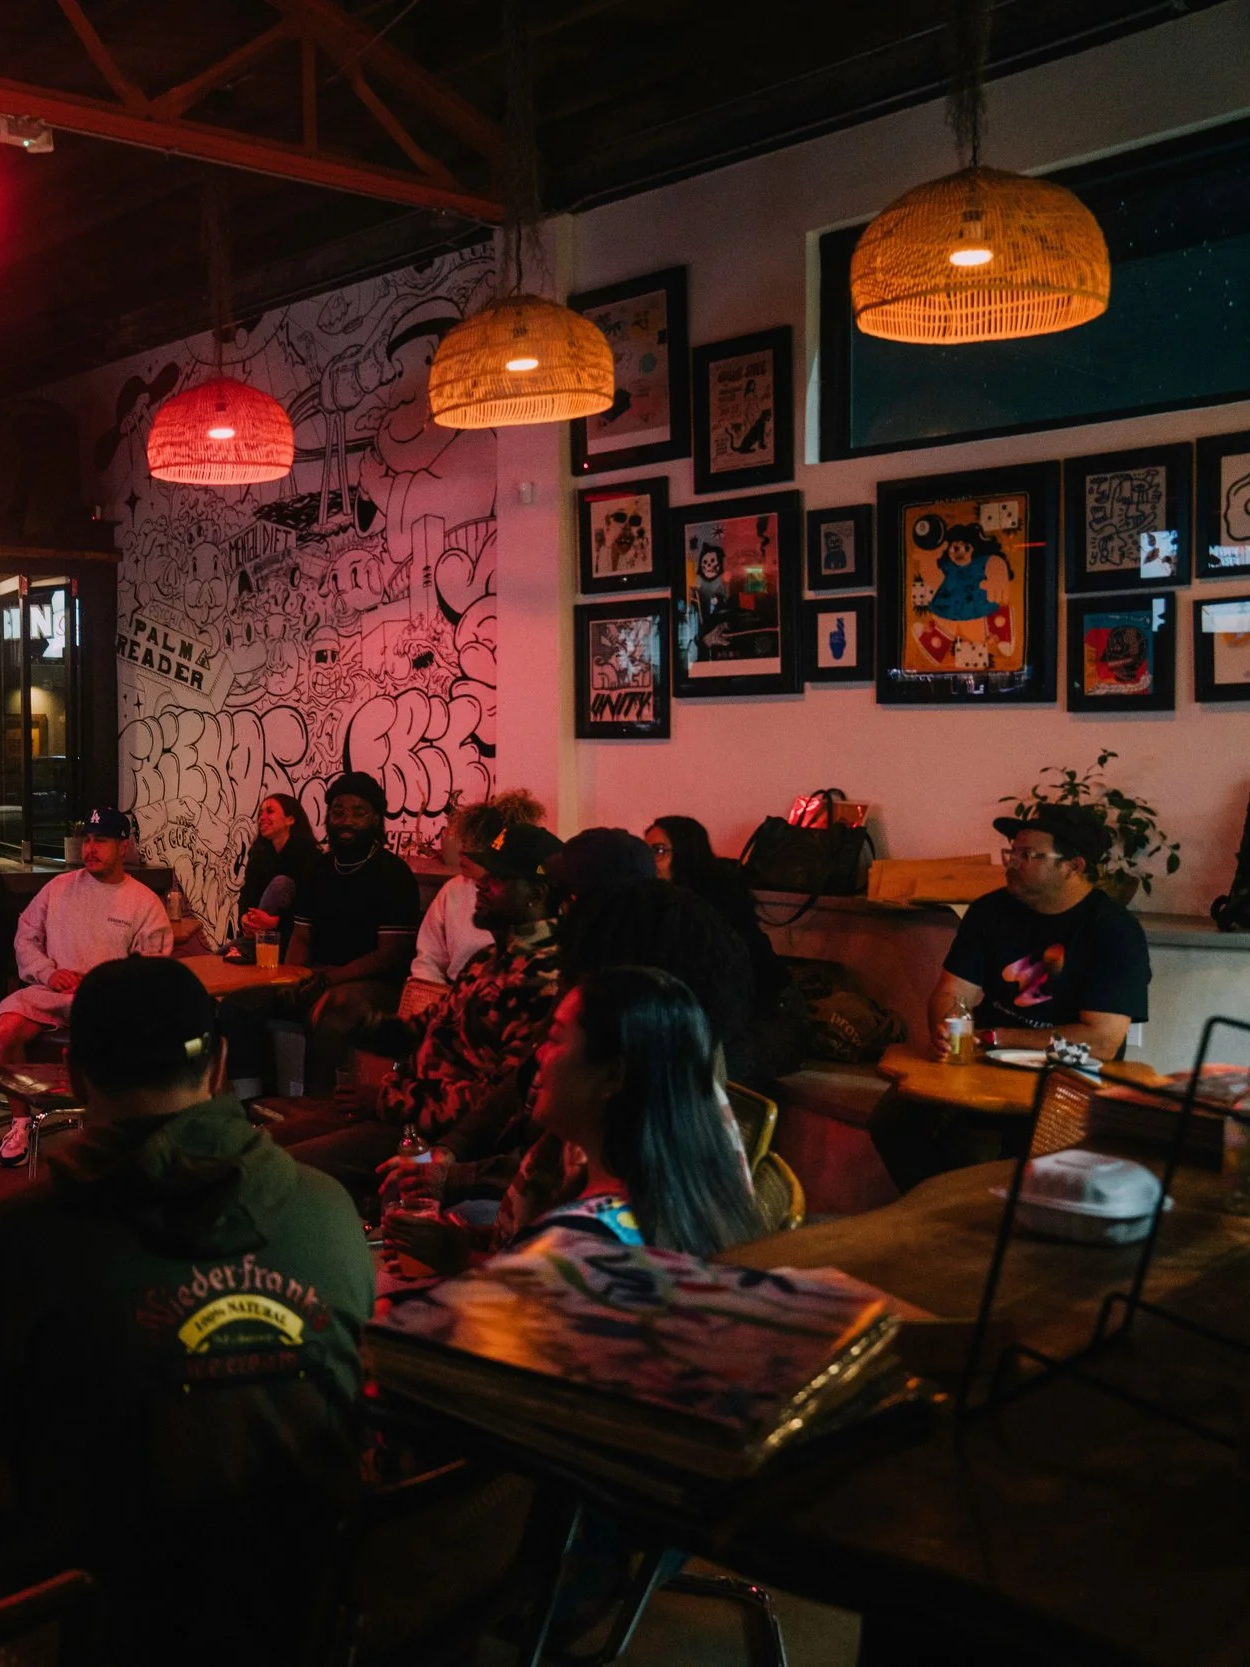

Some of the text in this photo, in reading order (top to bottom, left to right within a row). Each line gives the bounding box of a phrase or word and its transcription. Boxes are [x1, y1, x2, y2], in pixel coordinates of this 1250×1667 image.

[263, 523, 291, 554] DIET
[133, 618, 194, 662] PALM
[117, 633, 204, 690] READER
[592, 691, 652, 720] UNITY
[138, 845, 152, 865] SO
[153, 833, 167, 856] IT
[227, 1302, 287, 1326] NATURAL
